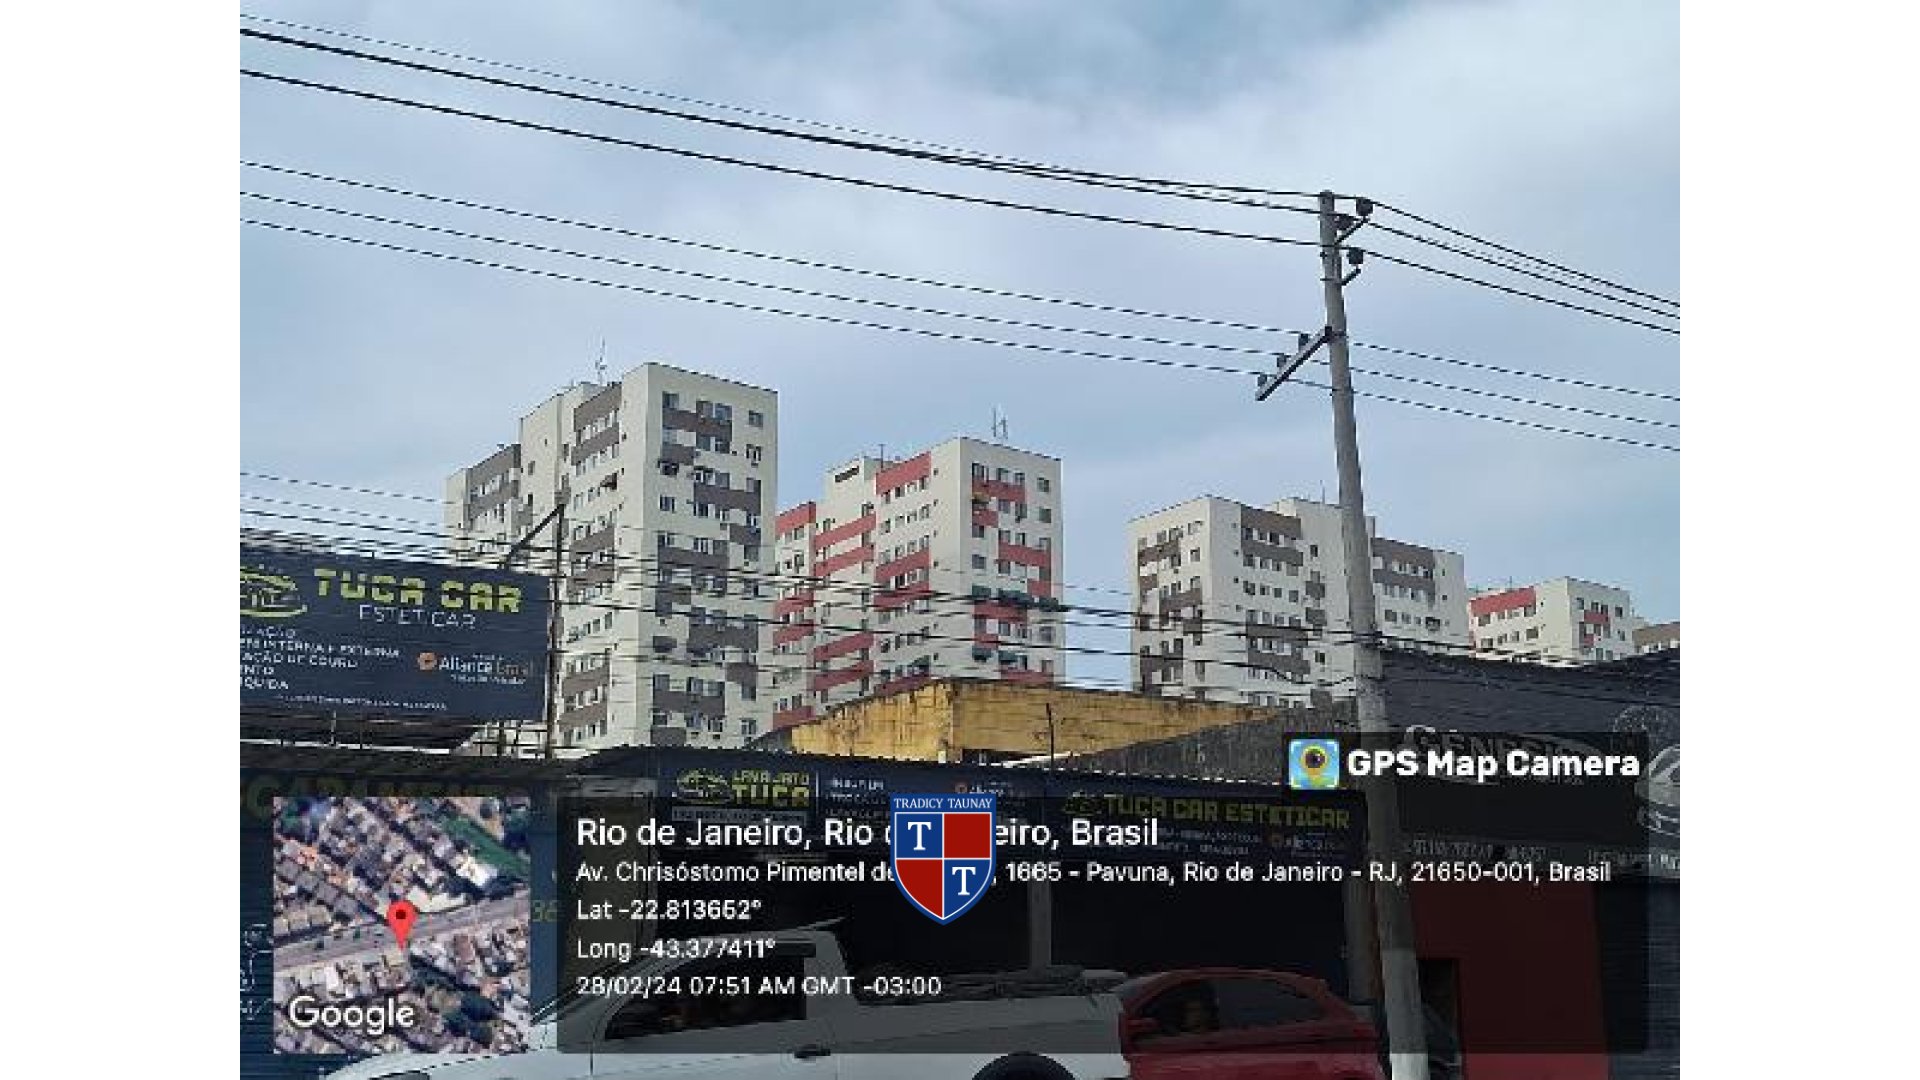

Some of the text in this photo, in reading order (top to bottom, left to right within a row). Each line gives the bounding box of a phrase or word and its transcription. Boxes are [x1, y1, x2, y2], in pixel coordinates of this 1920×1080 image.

[314, 569, 522, 613] TUCA CAR
[732, 784, 810, 808] TUCA
[1104, 796, 1167, 818] TUCA
[1172, 798, 1219, 822] CAR
